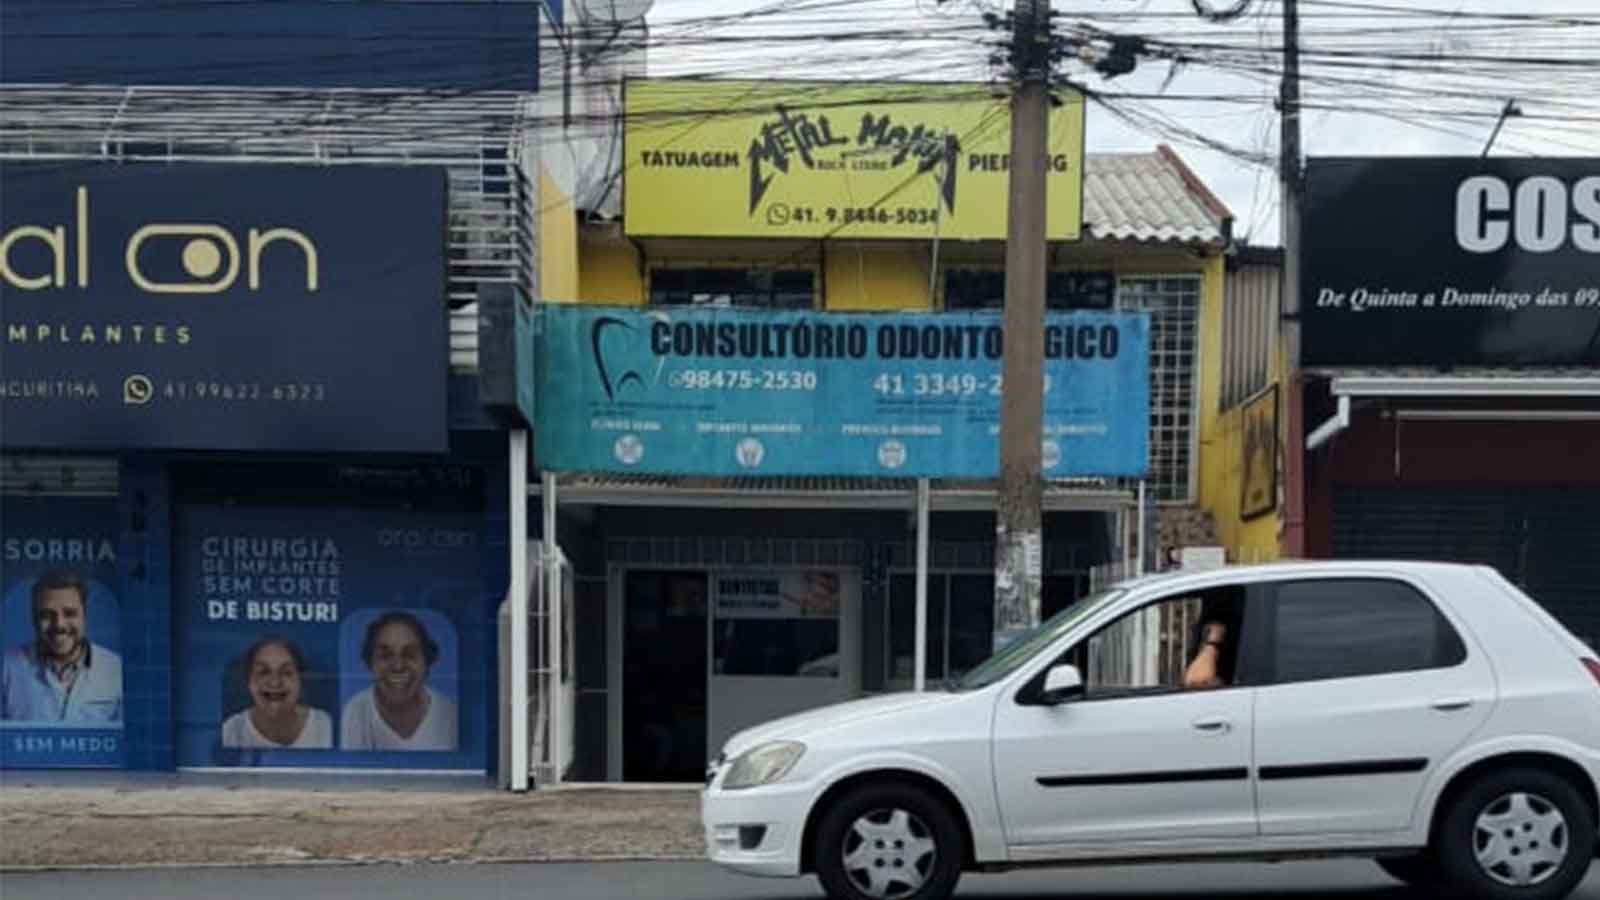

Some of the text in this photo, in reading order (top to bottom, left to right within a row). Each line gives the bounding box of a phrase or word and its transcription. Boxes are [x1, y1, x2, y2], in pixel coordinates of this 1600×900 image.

[641, 150, 739, 168] TATUAGEM
[969, 154, 1067, 172] PIERG
[1455, 176, 1600, 253] COS
[1316, 288, 1345, 307] De
[1350, 288, 1417, 311] Quinta
[1422, 294, 1436, 307] a
[1441, 288, 1530, 309] Domingo
[1535, 288, 1568, 306] das
[8, 324, 192, 344] MPLANTES
[651, 319, 1119, 360] CONSULTÓRIO ODONTOGICO
[682, 369, 817, 390] 98475-2530
[873, 374, 1051, 395] 41 3349-2
[5, 537, 116, 560] SORRIA
[201, 536, 338, 558] CIRURGIA
[234, 559, 339, 576] IMPLANTES
[204, 576, 339, 595] SEM CORTE
[208, 600, 337, 622] DE BISTURI
[15, 736, 117, 753] SEM MEDO
